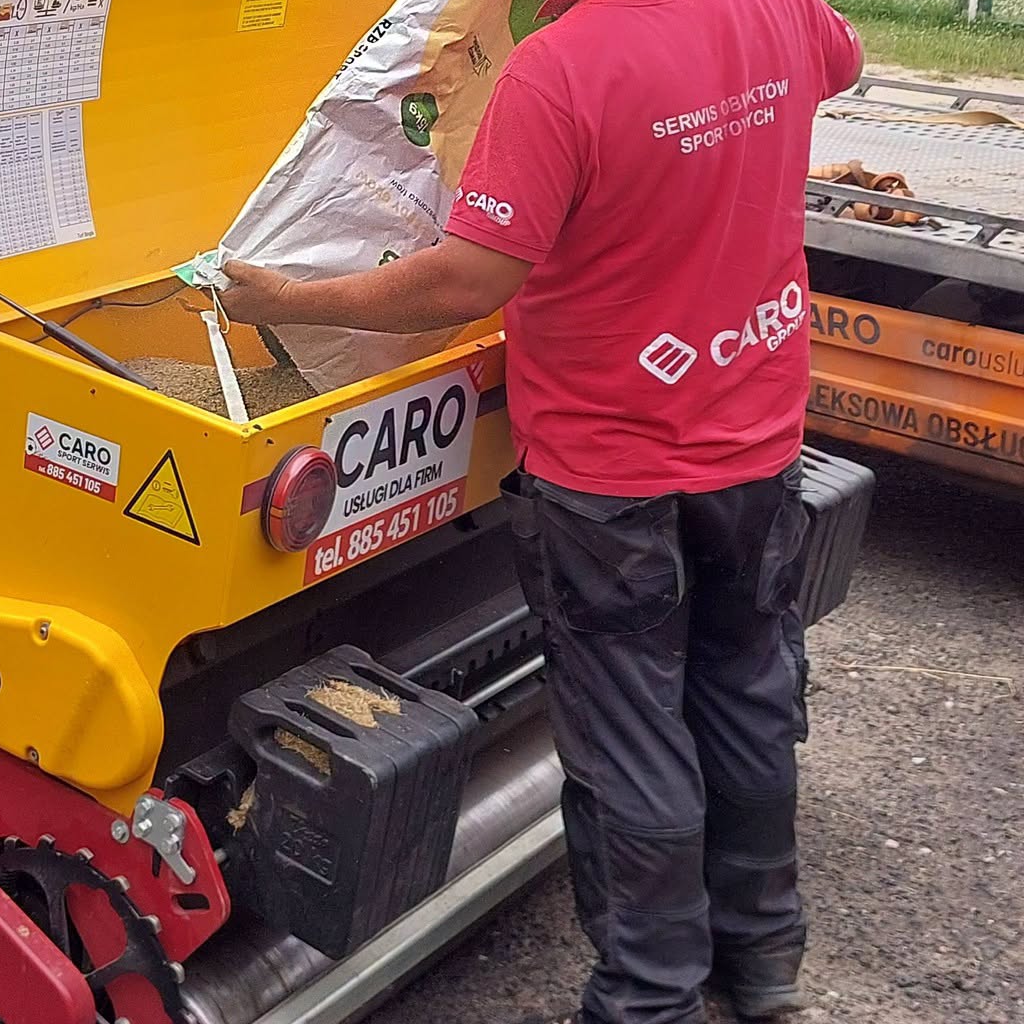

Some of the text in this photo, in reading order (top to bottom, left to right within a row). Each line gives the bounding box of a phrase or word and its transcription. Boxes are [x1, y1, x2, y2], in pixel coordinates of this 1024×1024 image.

[366, 18, 393, 44] RZB
[652, 104, 718, 138] SERWIS
[466, 191, 514, 220] CARO
[710, 280, 803, 366] CARO
[810, 304, 881, 345] ARO
[810, 384, 919, 432] EKSOWA
[58, 432, 111, 466] CARO
[334, 384, 466, 488] CARO
[46, 464, 66, 480] 885
[66, 472, 83, 487] 451
[84, 478, 101, 494] 105
[57, 450, 110, 476] SPORT SERWIS
[344, 462, 444, 517] USŁUGI DLA FIRM
[314, 488, 459, 576] tel. 885 451 105
